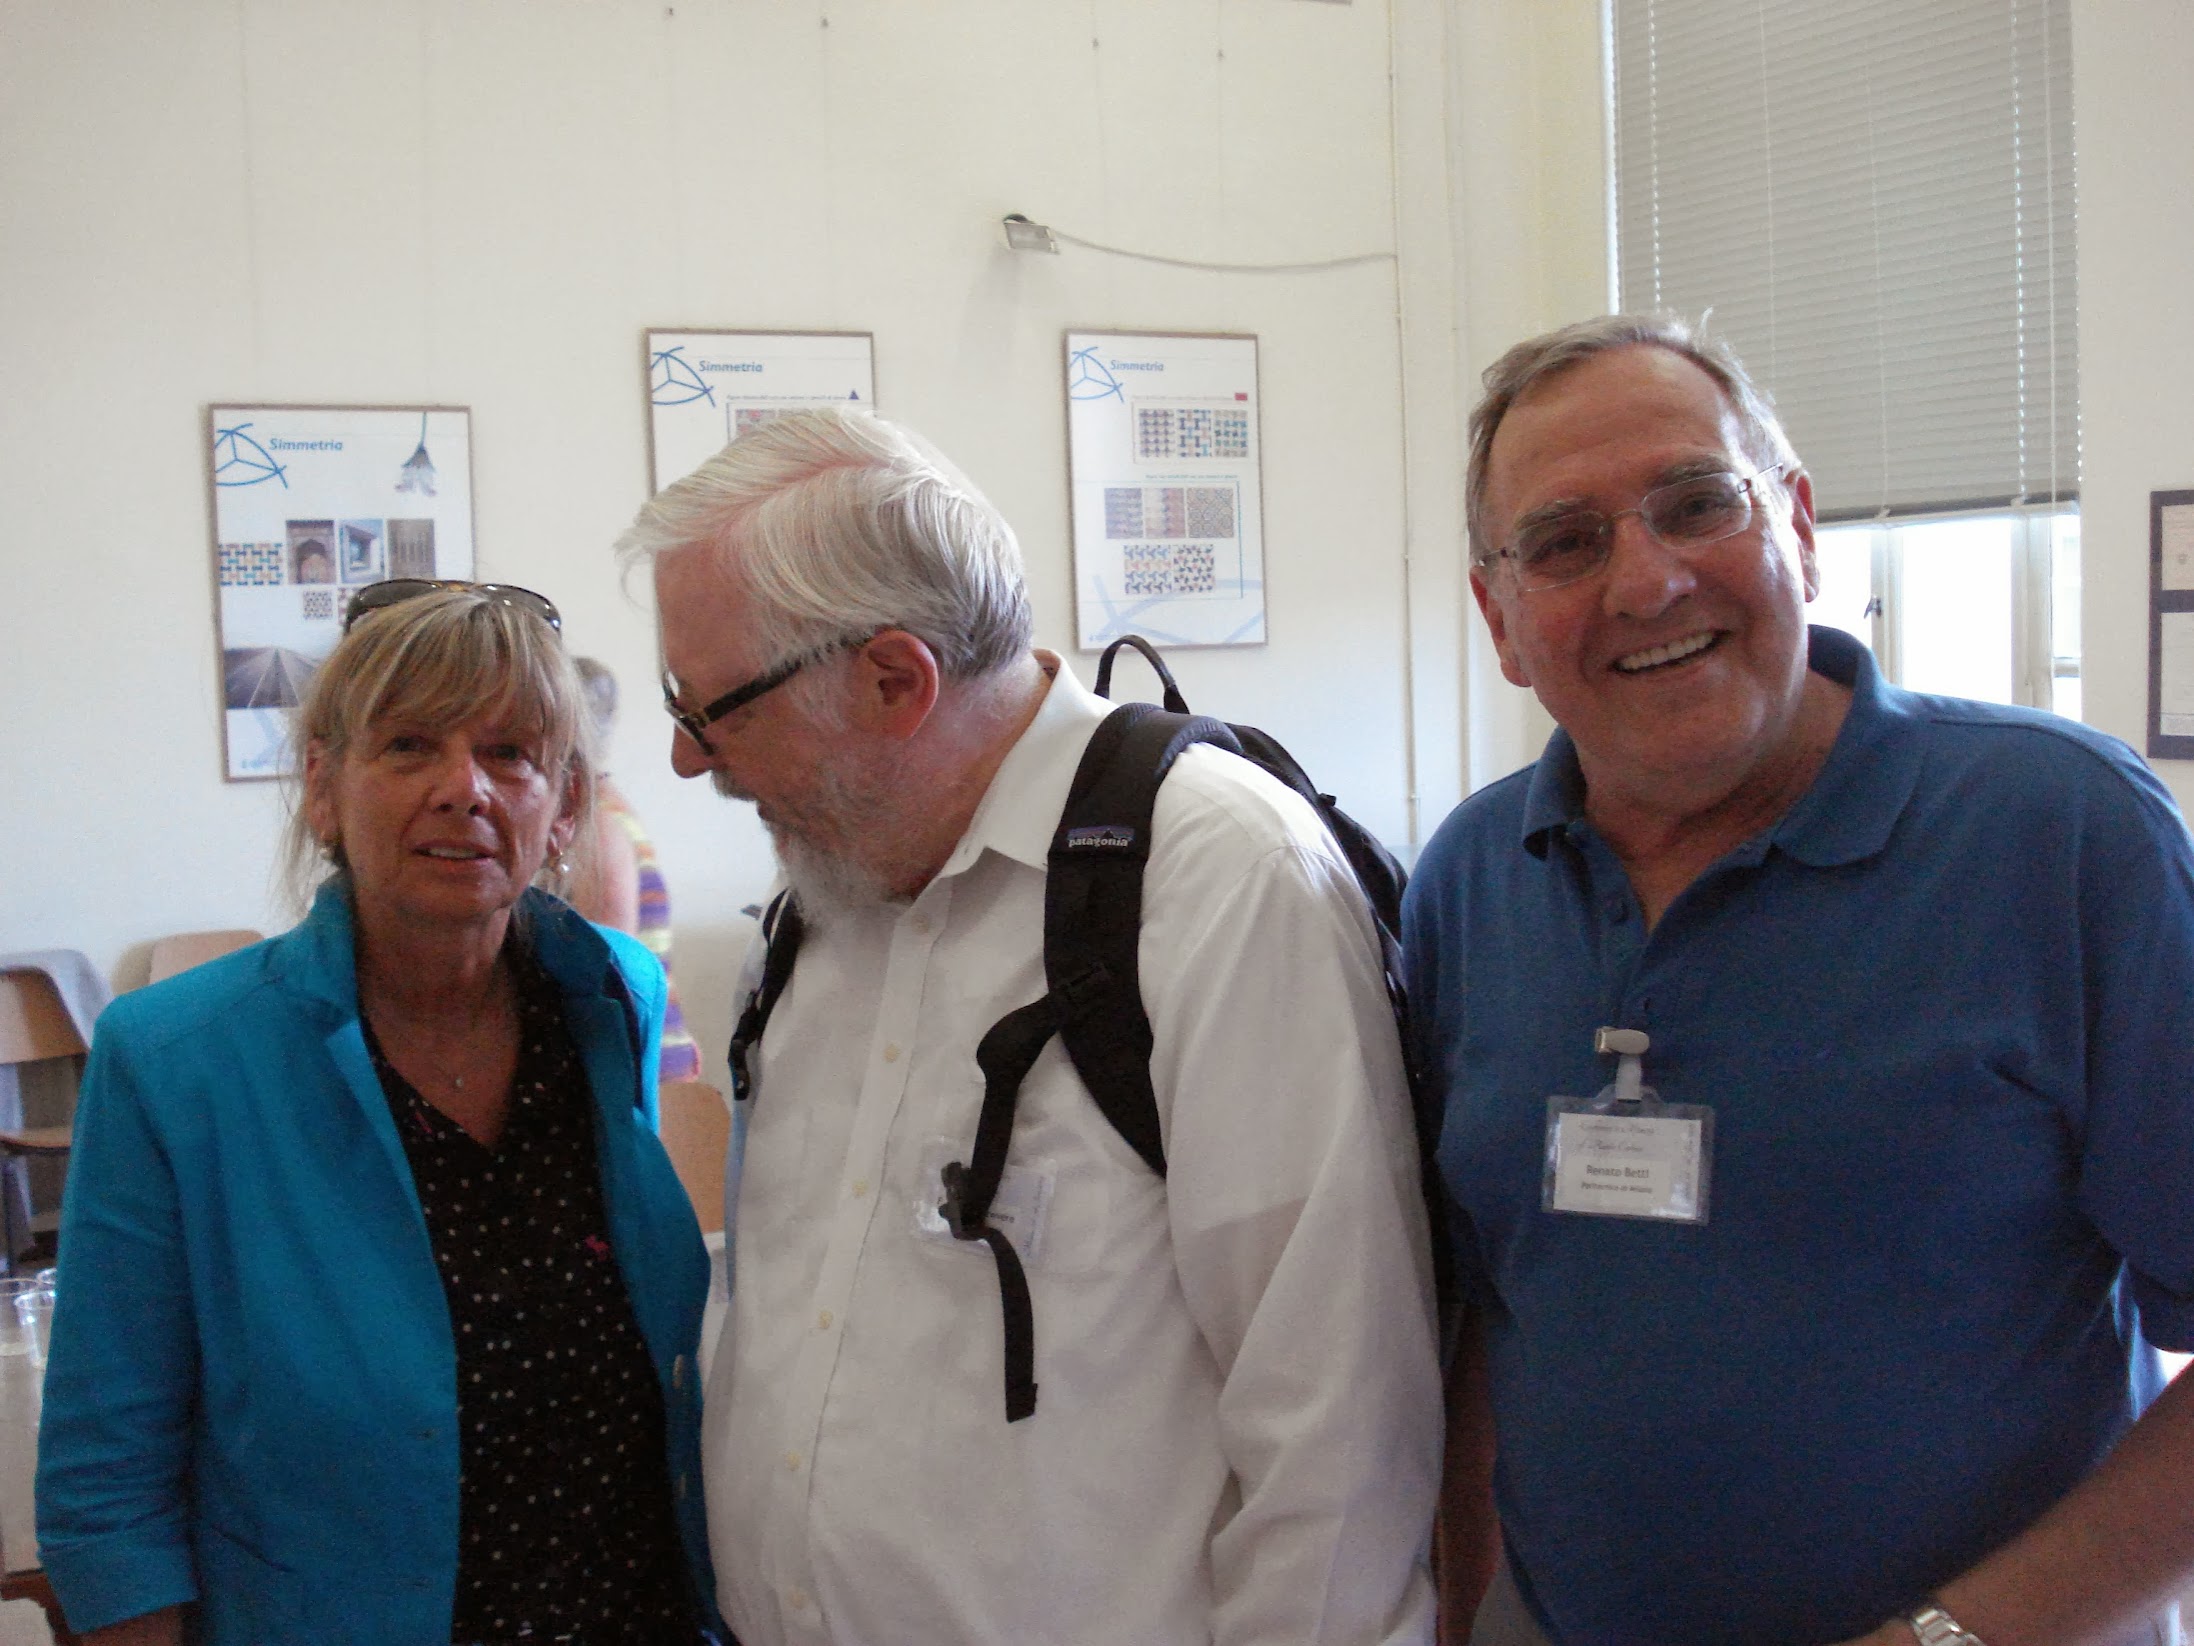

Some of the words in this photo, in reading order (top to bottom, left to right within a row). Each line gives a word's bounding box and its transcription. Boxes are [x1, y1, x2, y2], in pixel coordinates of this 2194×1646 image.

[699, 360, 763, 373] Simmetria
[1110, 359, 1164, 372] Simmetria
[269, 437, 344, 451] Simmetria
[1068, 837, 1129, 848] patagonia
